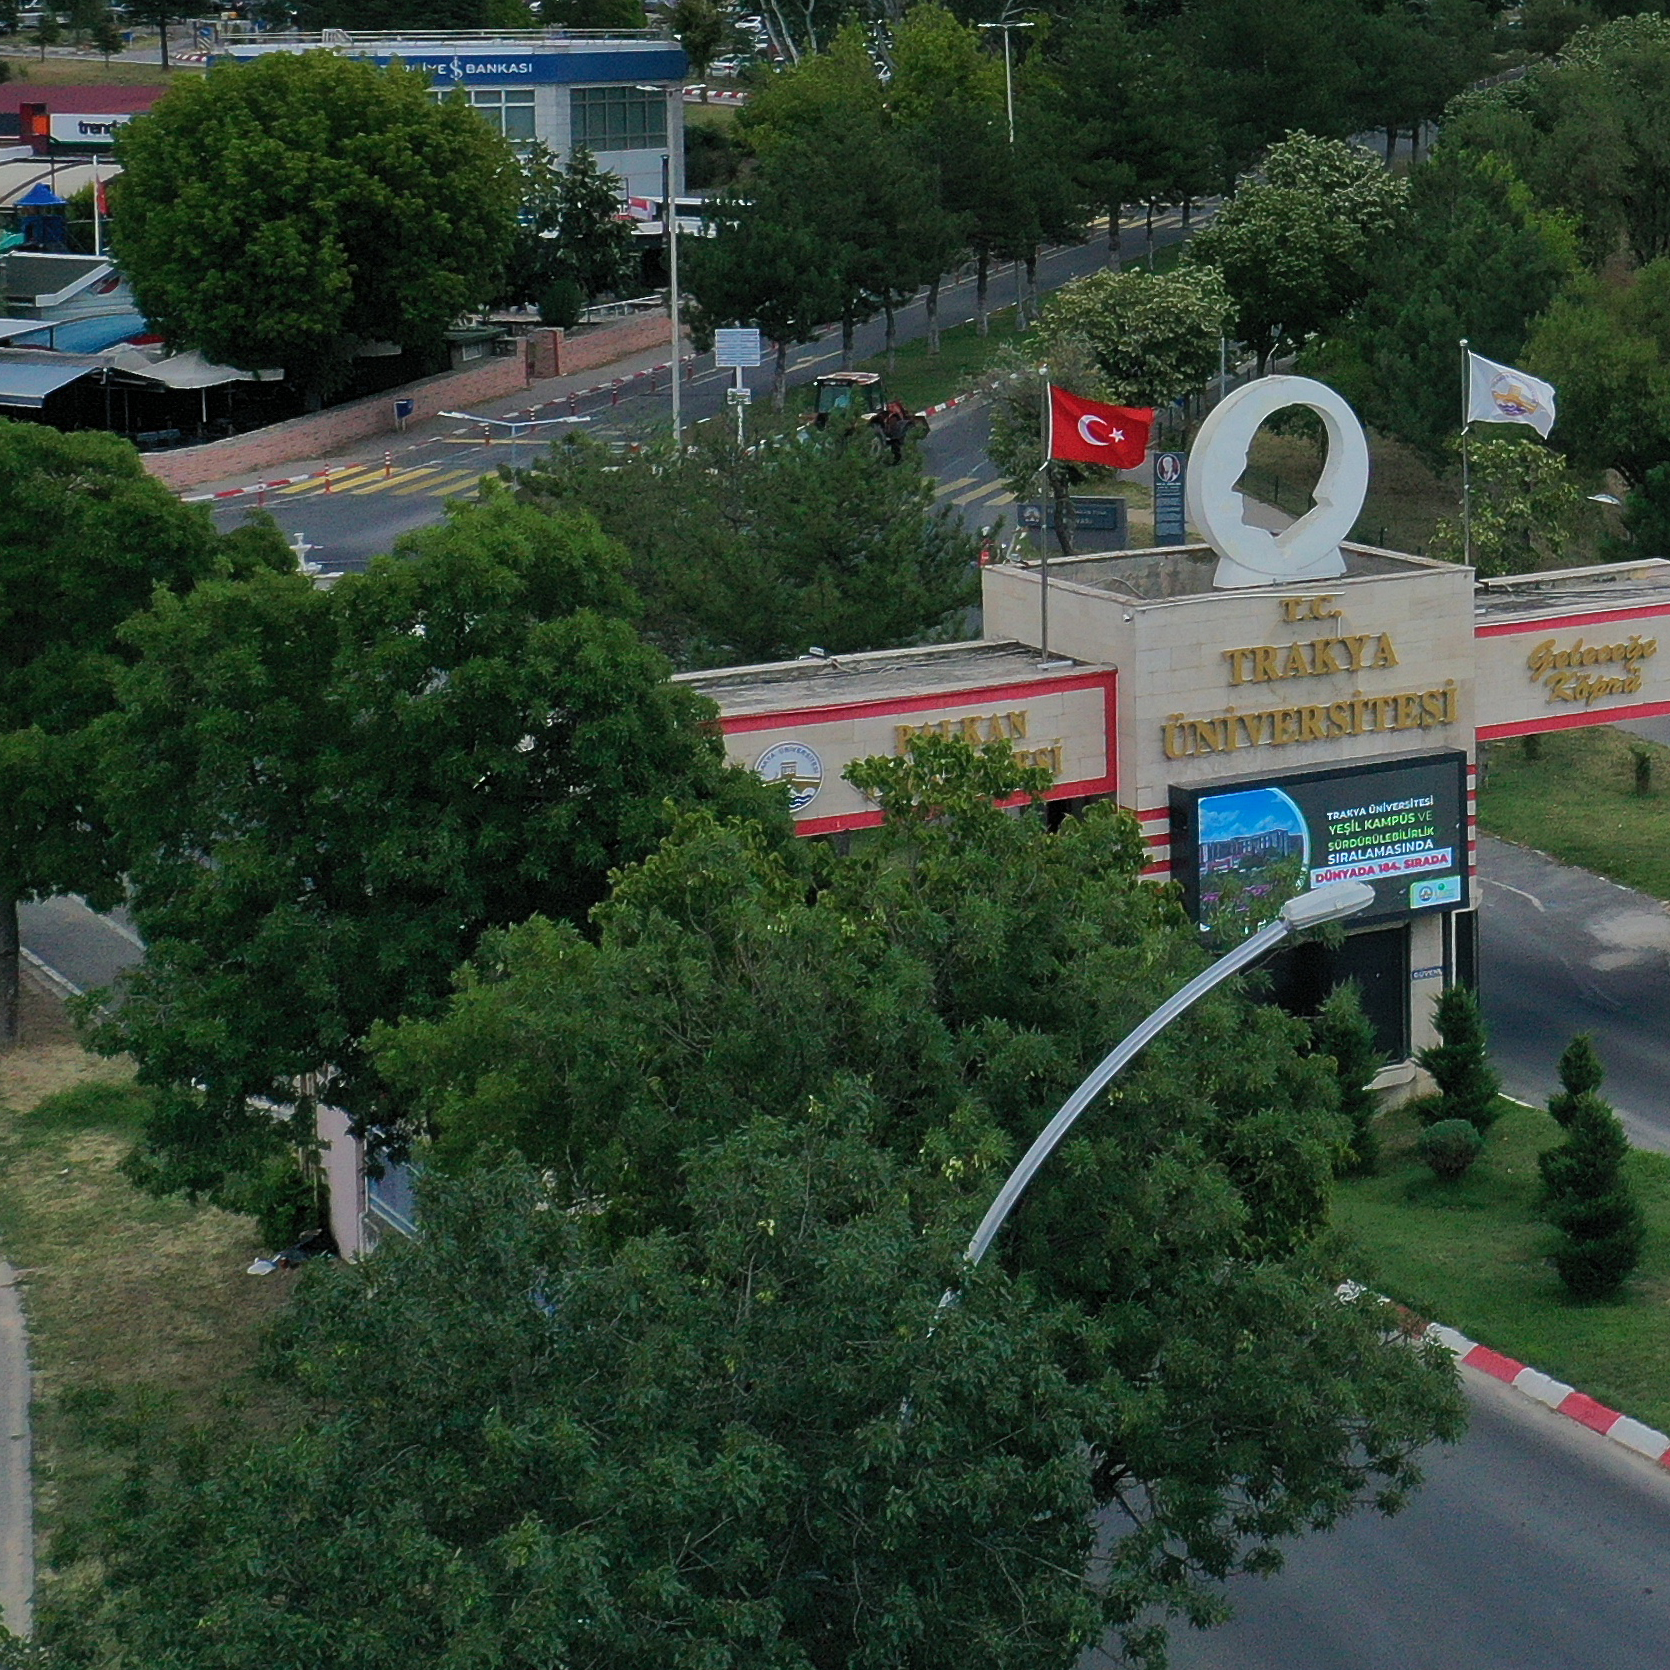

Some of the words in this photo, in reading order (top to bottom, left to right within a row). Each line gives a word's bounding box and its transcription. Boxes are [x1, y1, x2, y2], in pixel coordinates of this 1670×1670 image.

[466, 63, 533, 74] BANKASI
[1279, 594, 1343, 622] T.C.
[1221, 632, 1399, 686] TRAKYA
[1161, 679, 1459, 759] ÜNİVERSİTESİ
[1327, 808, 1367, 821] TRAKYA
[1368, 795, 1434, 814] ÜNİVERSİTESİ
[1329, 820, 1362, 836] YEŞİL
[1364, 812, 1415, 831] KAMPÜS
[1418, 810, 1433, 822] VE
[1327, 839, 1434, 865] SIRALAMASINDA
[1328, 825, 1434, 852] SÜRDÜRÜLEBİLİRLİK
[1315, 865, 1376, 883] DÜNYADA
[1403, 853, 1448, 870] SIRADA
